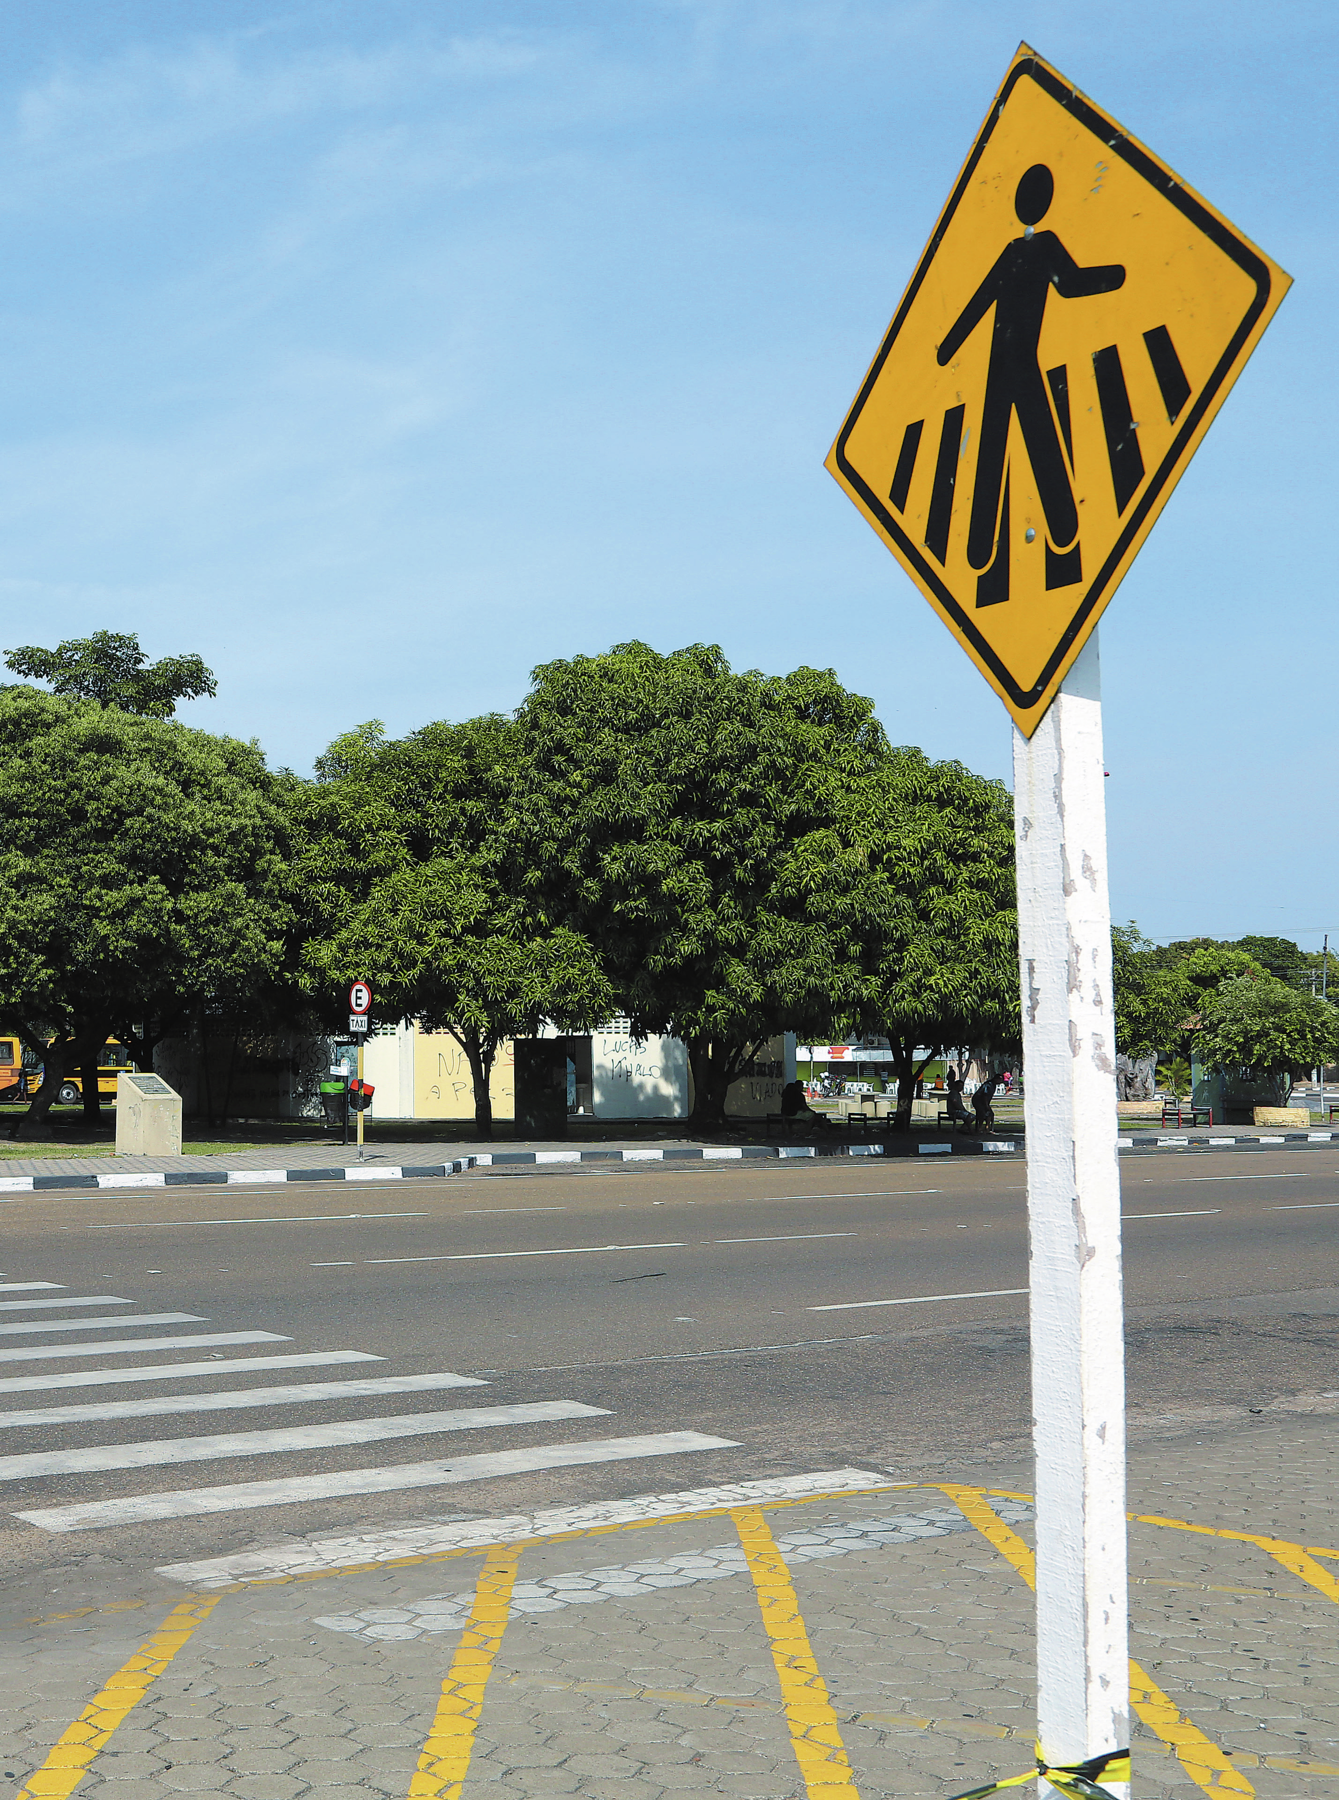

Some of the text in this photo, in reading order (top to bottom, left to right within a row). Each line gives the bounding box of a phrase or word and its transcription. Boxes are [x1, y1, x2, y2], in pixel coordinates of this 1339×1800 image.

[355, 988, 363, 1007] E
[351, 1019, 366, 1029] TAXI
[603, 1039, 647, 1056] LUCAS
